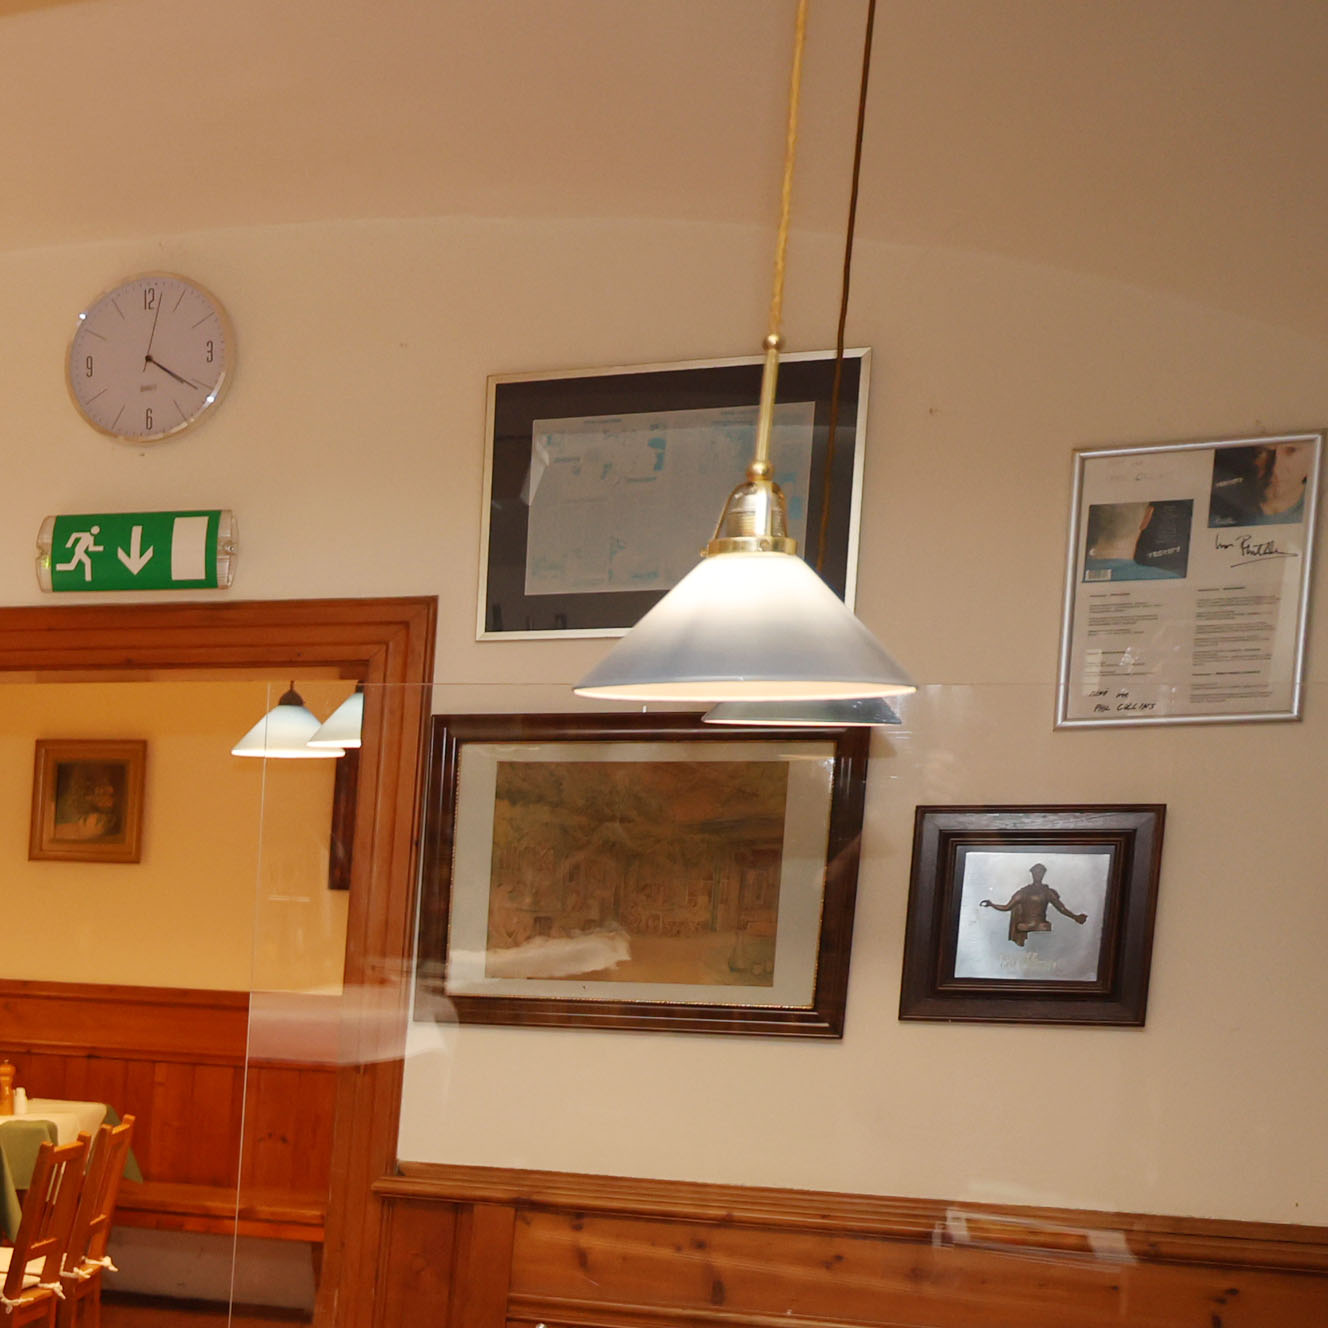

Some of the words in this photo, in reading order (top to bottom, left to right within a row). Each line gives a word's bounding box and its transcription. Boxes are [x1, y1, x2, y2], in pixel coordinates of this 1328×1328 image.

[144, 288, 155, 310] 12
[206, 340, 214, 363] 3
[86, 356, 93, 378] 9
[145, 408, 153, 430] 6
